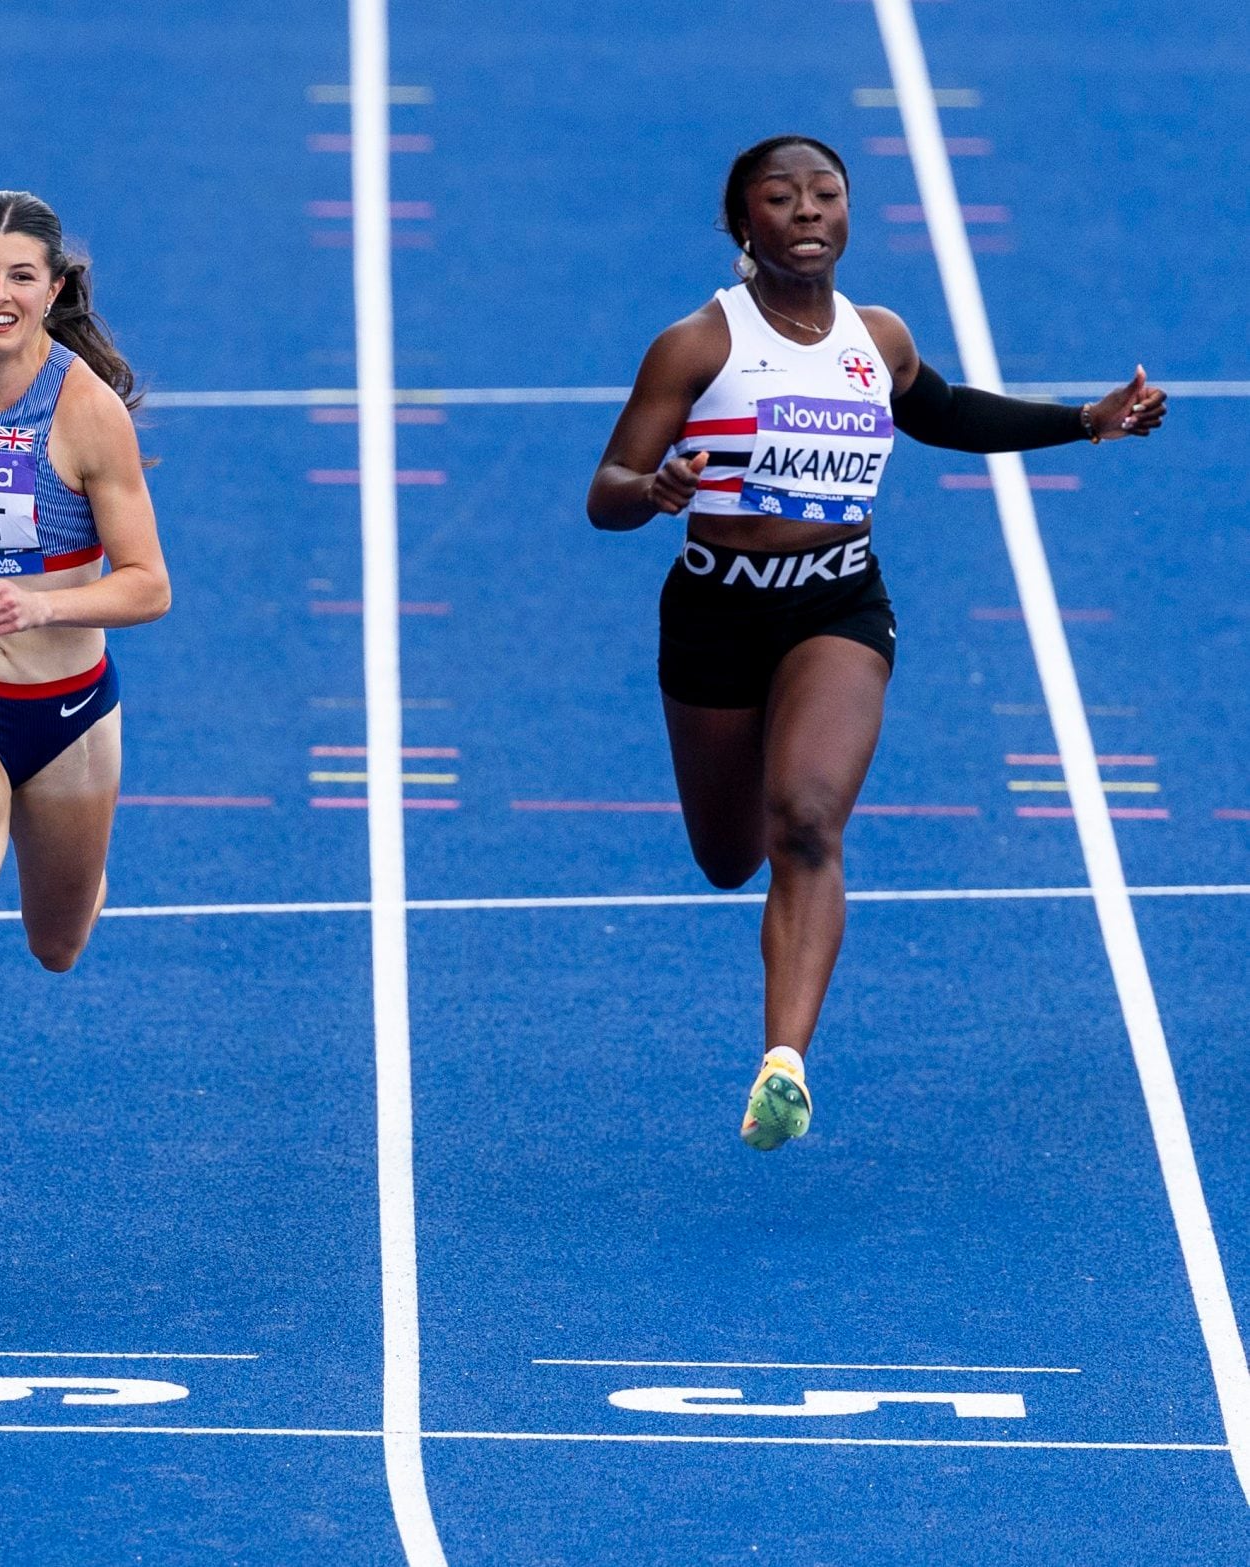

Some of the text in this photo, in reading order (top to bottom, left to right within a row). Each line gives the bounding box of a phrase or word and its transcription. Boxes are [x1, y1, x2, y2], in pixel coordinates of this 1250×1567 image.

[773, 400, 876, 433] Novuna
[754, 446, 882, 484] AKANDE
[723, 535, 870, 589] NIKE
[608, 1387, 1026, 1418] 5
